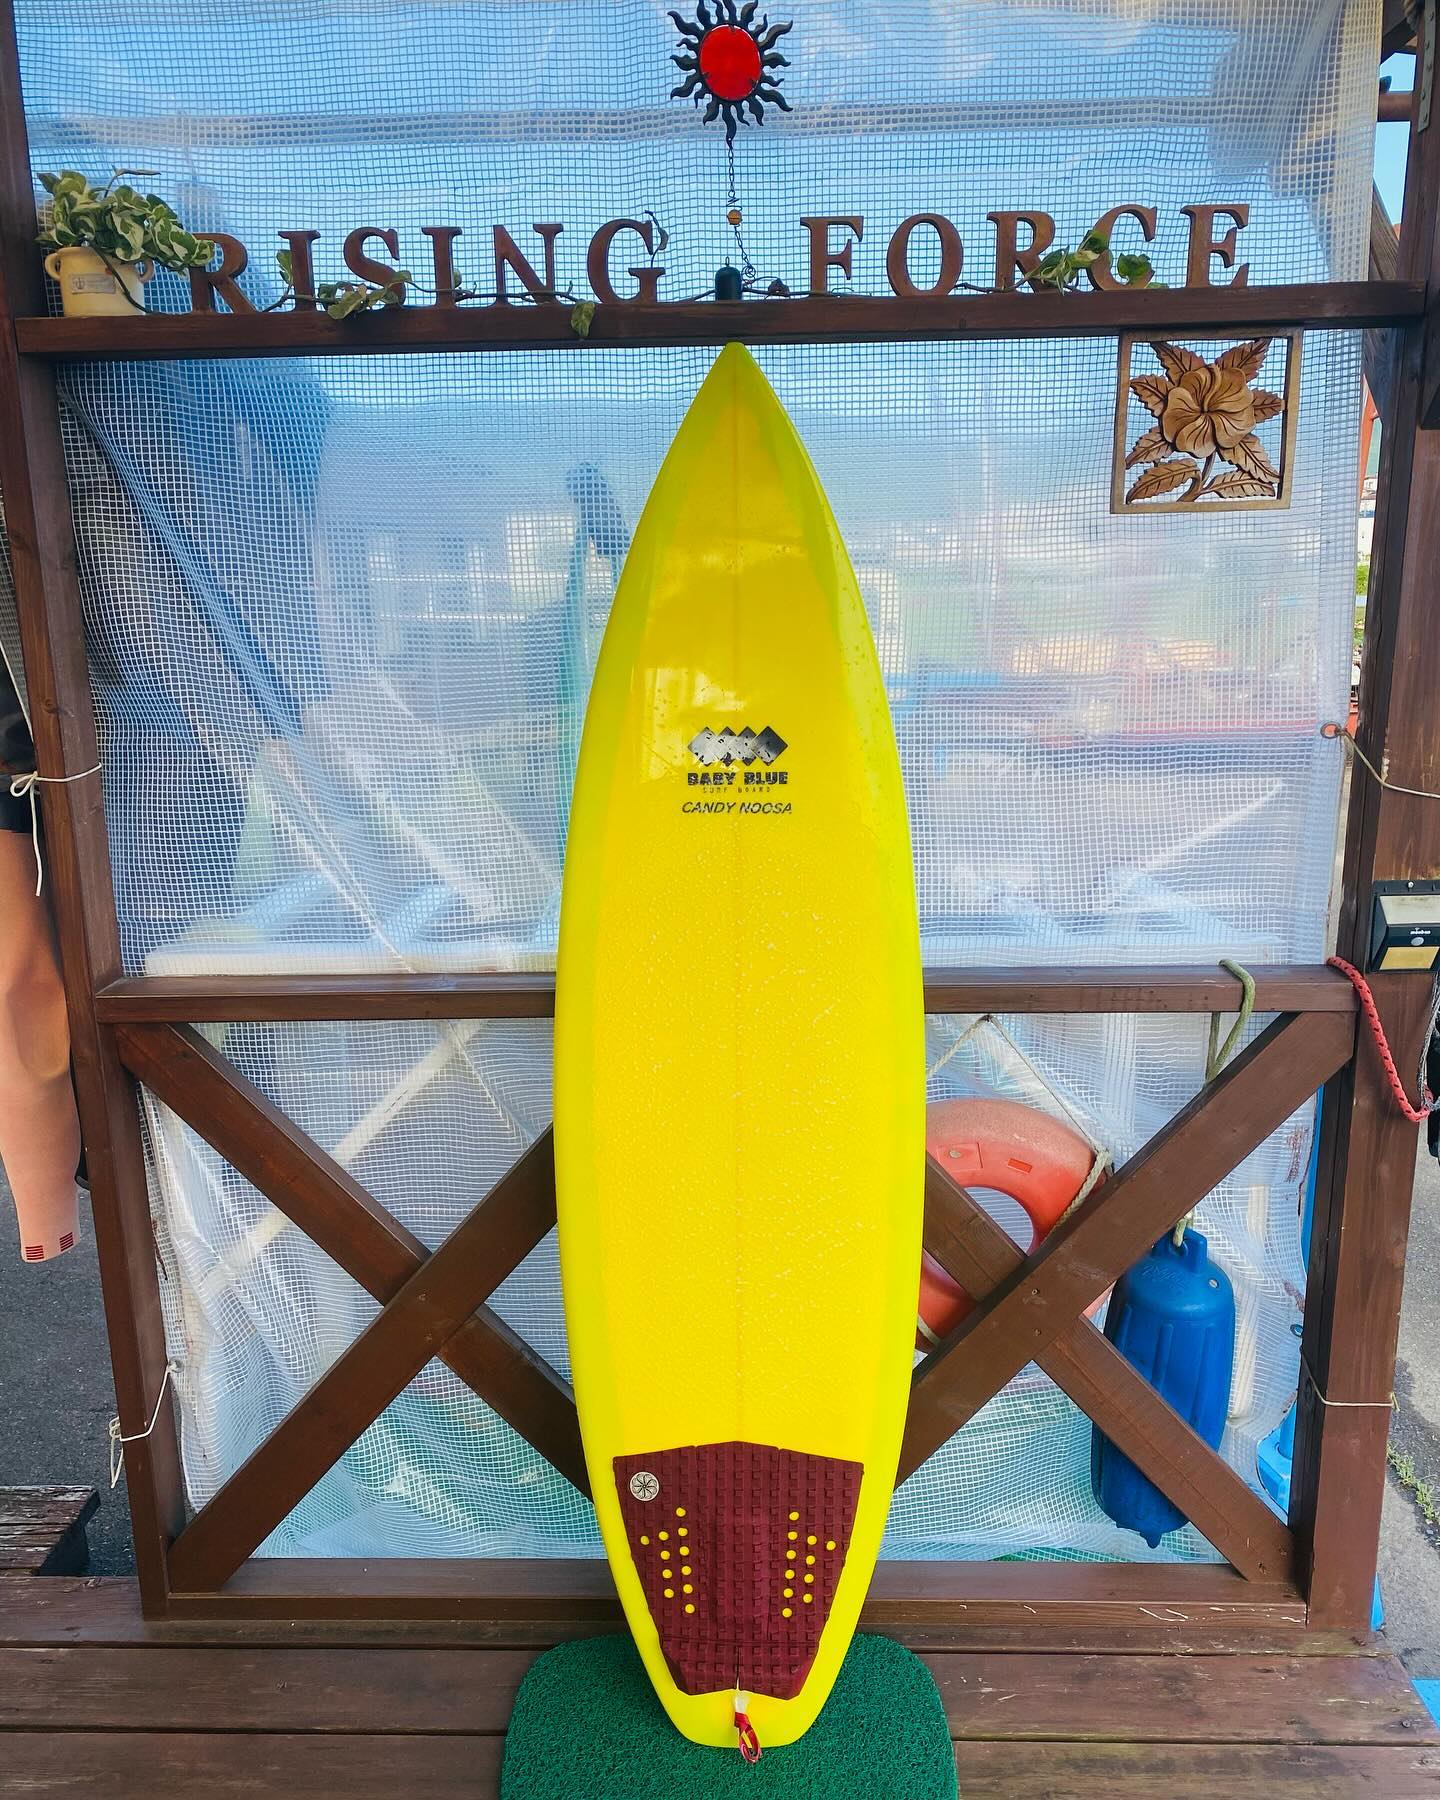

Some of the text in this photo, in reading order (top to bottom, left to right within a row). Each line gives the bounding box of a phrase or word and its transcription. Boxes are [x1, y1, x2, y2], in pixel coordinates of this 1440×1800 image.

[188, 203, 1250, 314] RISING FORCE
[688, 772, 788, 785] BABY BLUE
[682, 802, 792, 814] CANDY NOOSA
